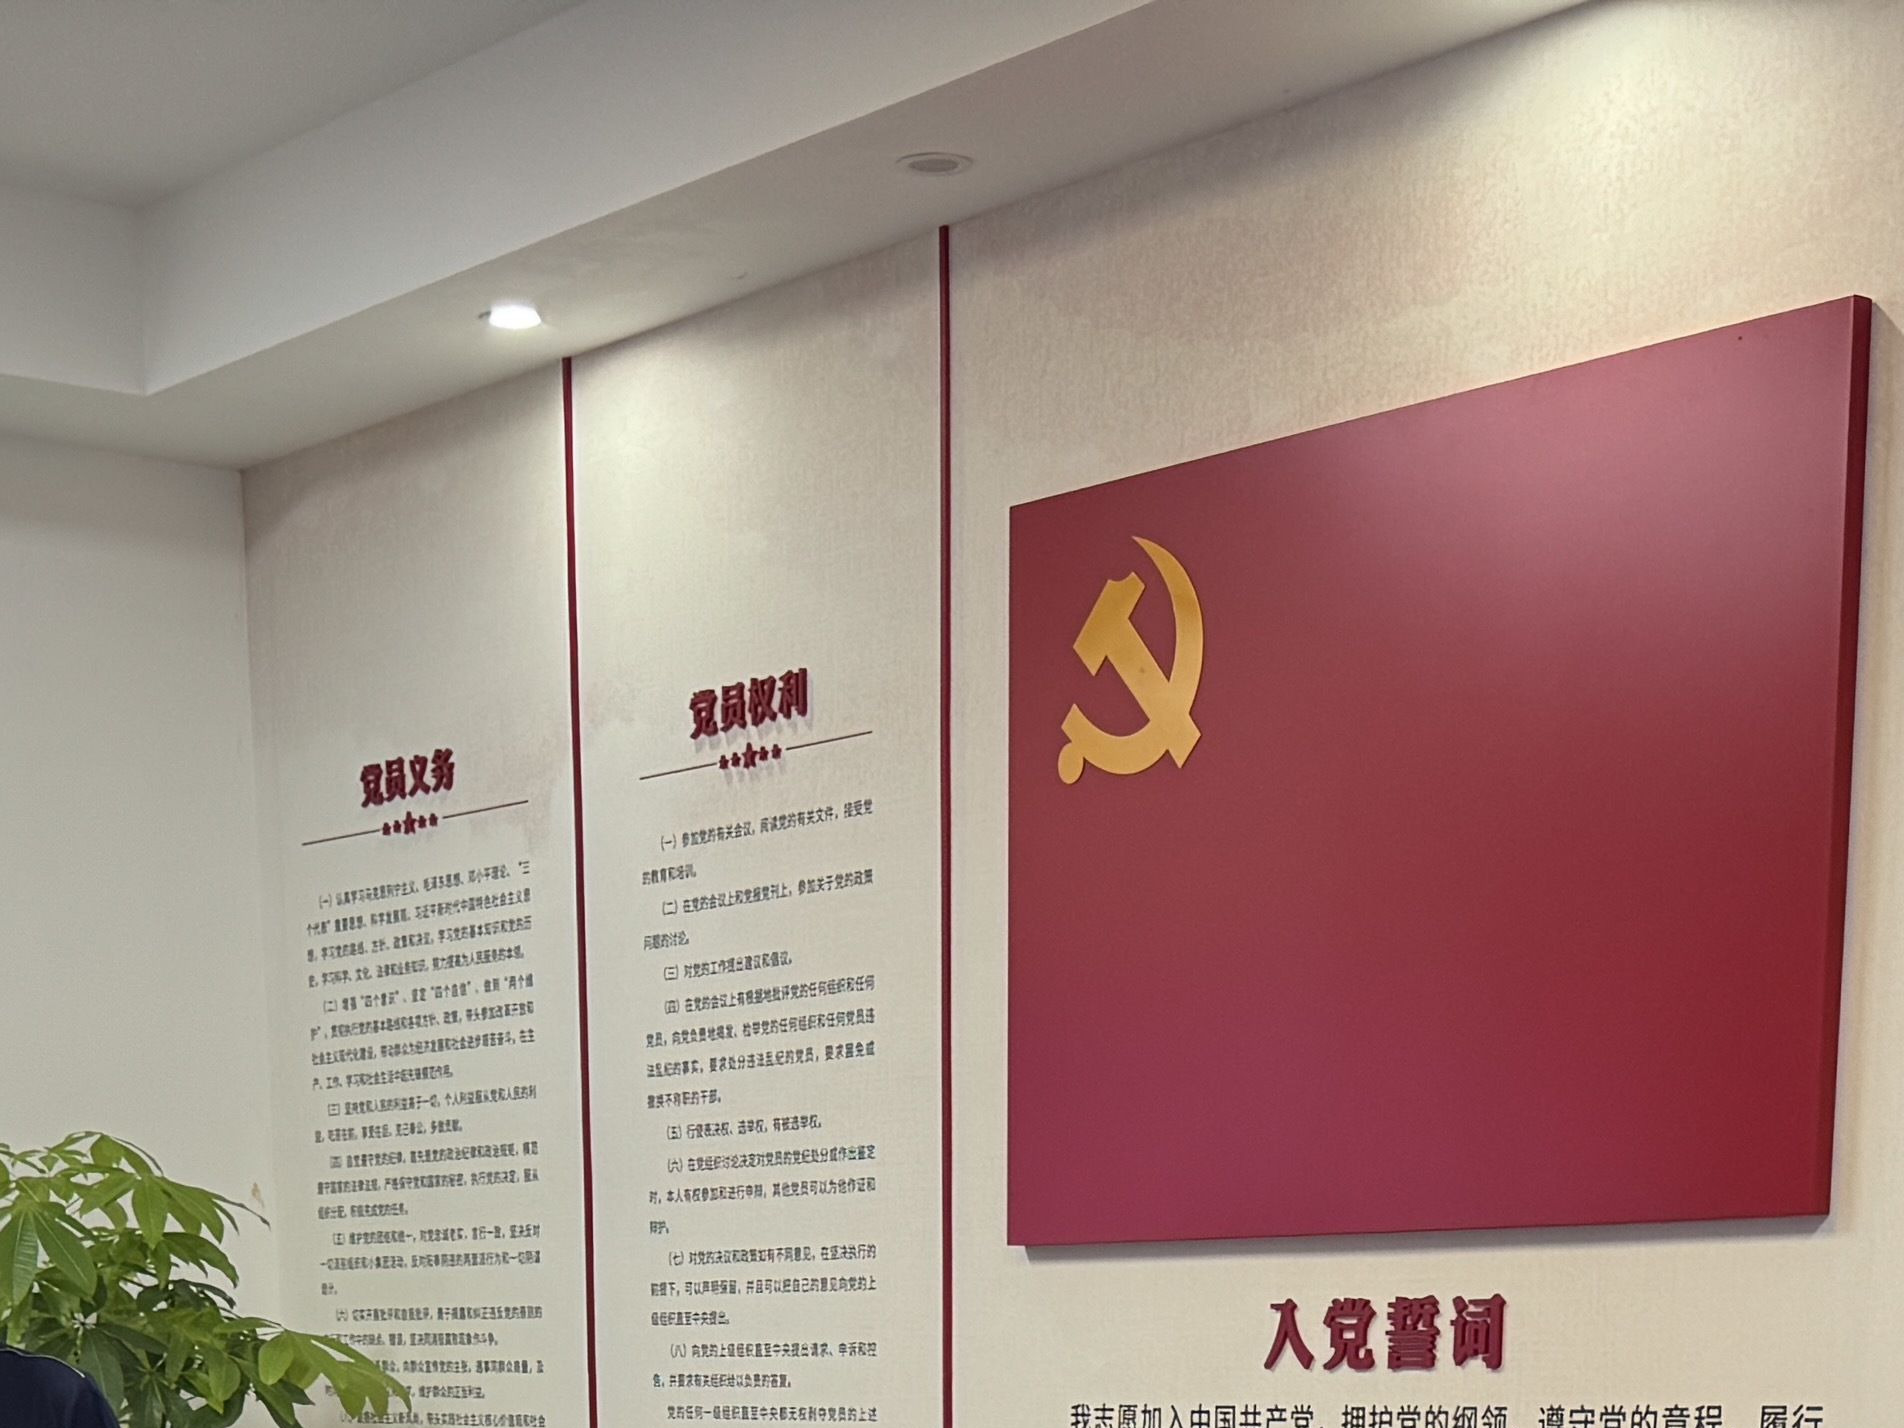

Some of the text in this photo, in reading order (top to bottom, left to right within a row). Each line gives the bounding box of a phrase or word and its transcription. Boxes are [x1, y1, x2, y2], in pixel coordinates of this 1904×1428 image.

[688, 668, 809, 740] 党员权利
[360, 749, 455, 807] 党员义务
[1264, 1293, 1507, 1372] 入党誓词
